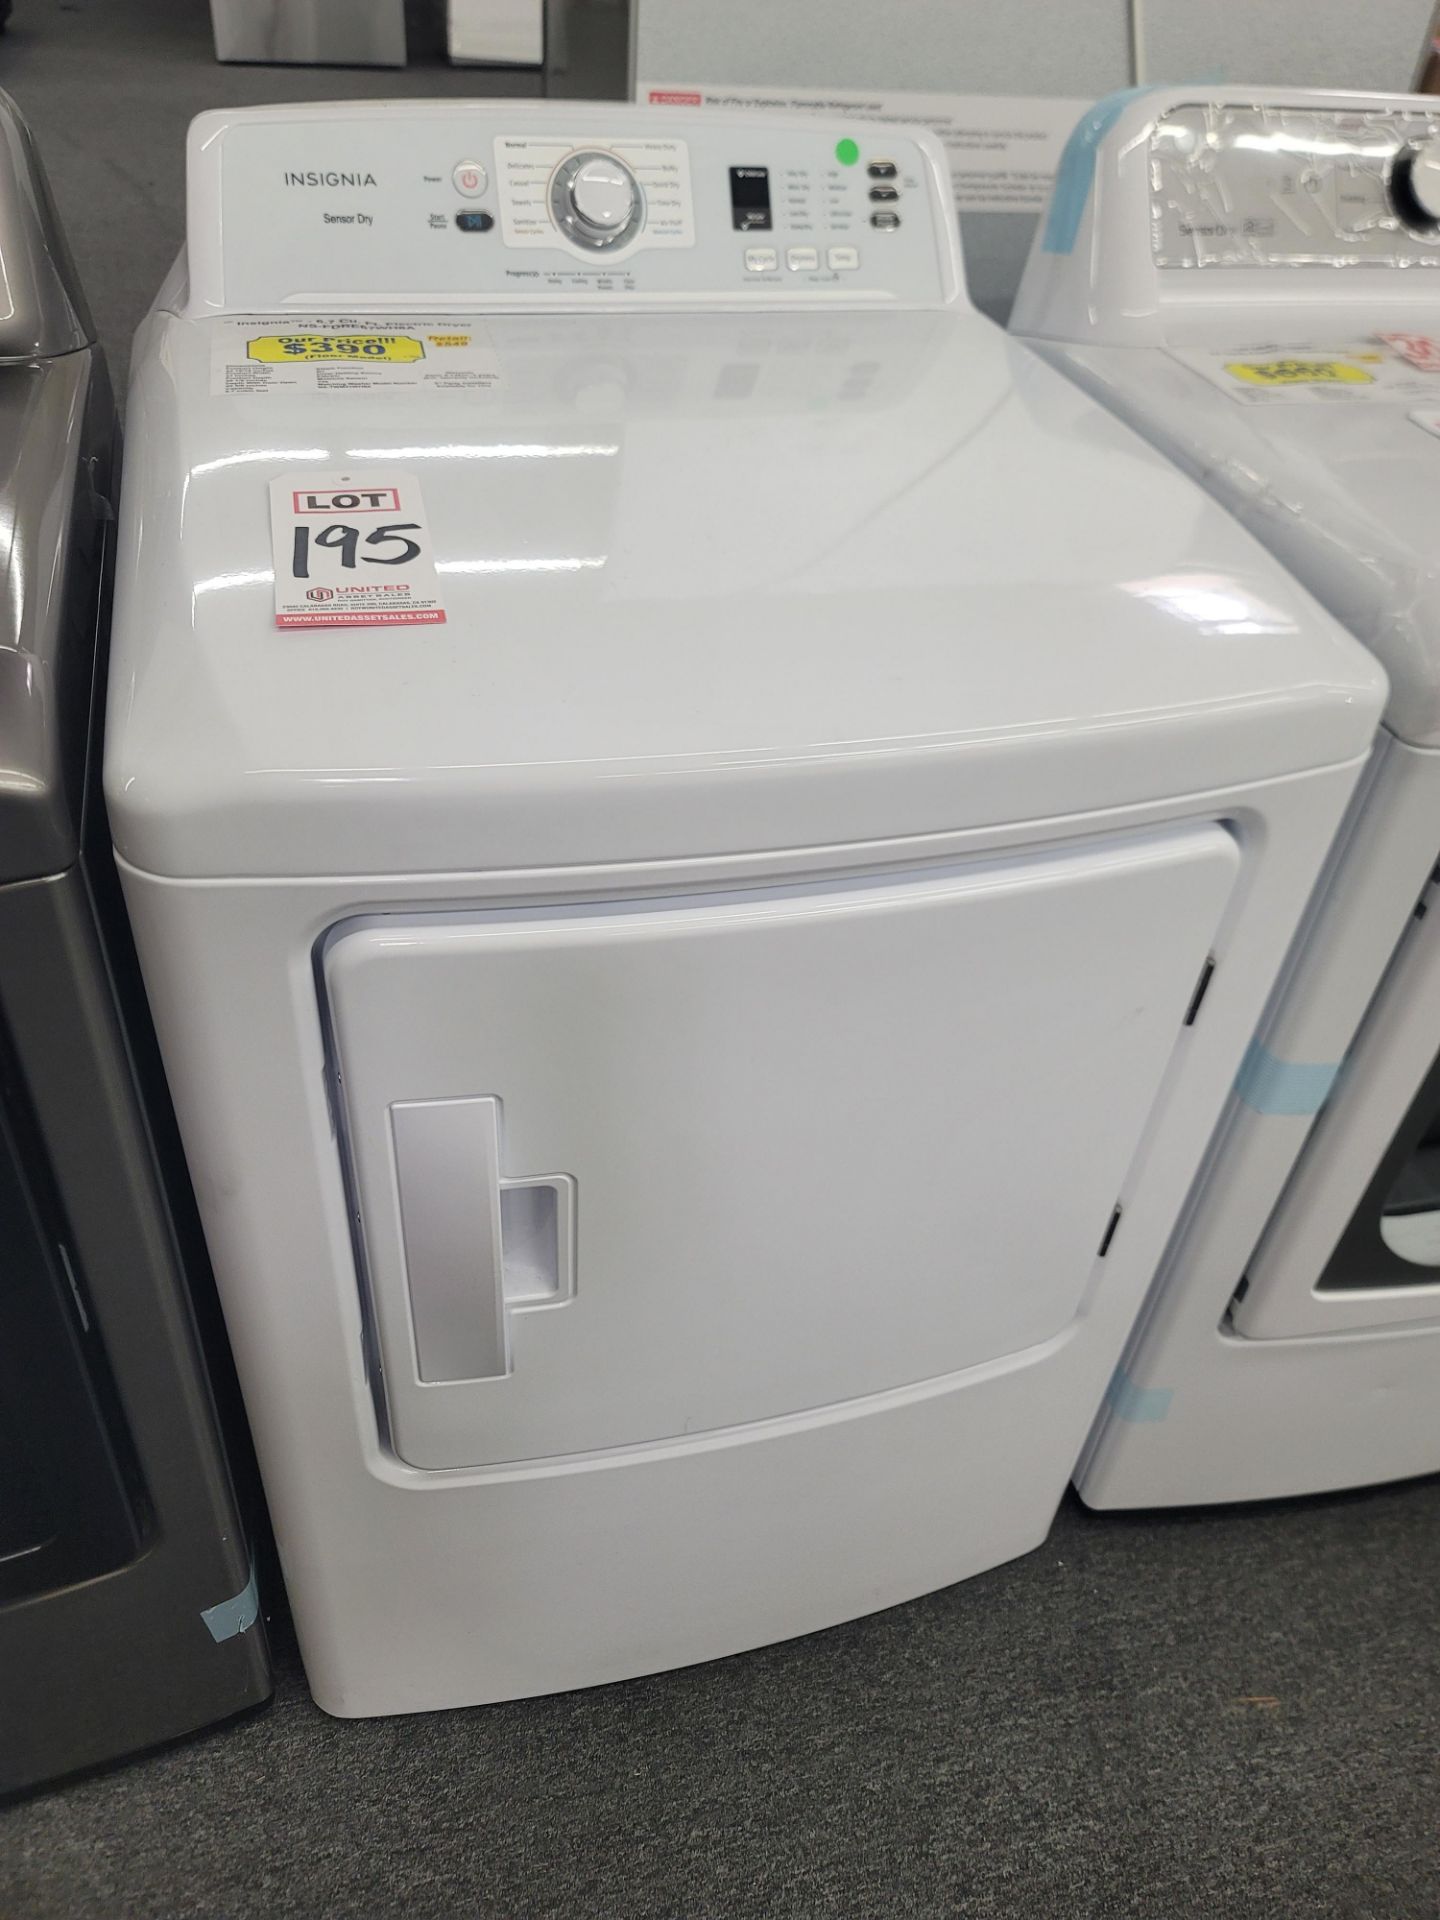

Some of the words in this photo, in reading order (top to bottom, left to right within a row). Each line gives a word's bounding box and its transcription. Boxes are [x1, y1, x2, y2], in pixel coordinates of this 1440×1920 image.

[284, 171, 378, 187] INSIGNIA
[322, 212, 355, 225] Sensor
[357, 212, 374, 227] Dry
[277, 336, 317, 345] Our
[322, 336, 396, 345] Price!!!
[282, 342, 387, 356] $390
[307, 492, 388, 510] LOT
[292, 523, 423, 579] 195
[335, 584, 411, 593] UNITED
[282, 612, 440, 623] WWW.UNITEDASSETSALES.COM
